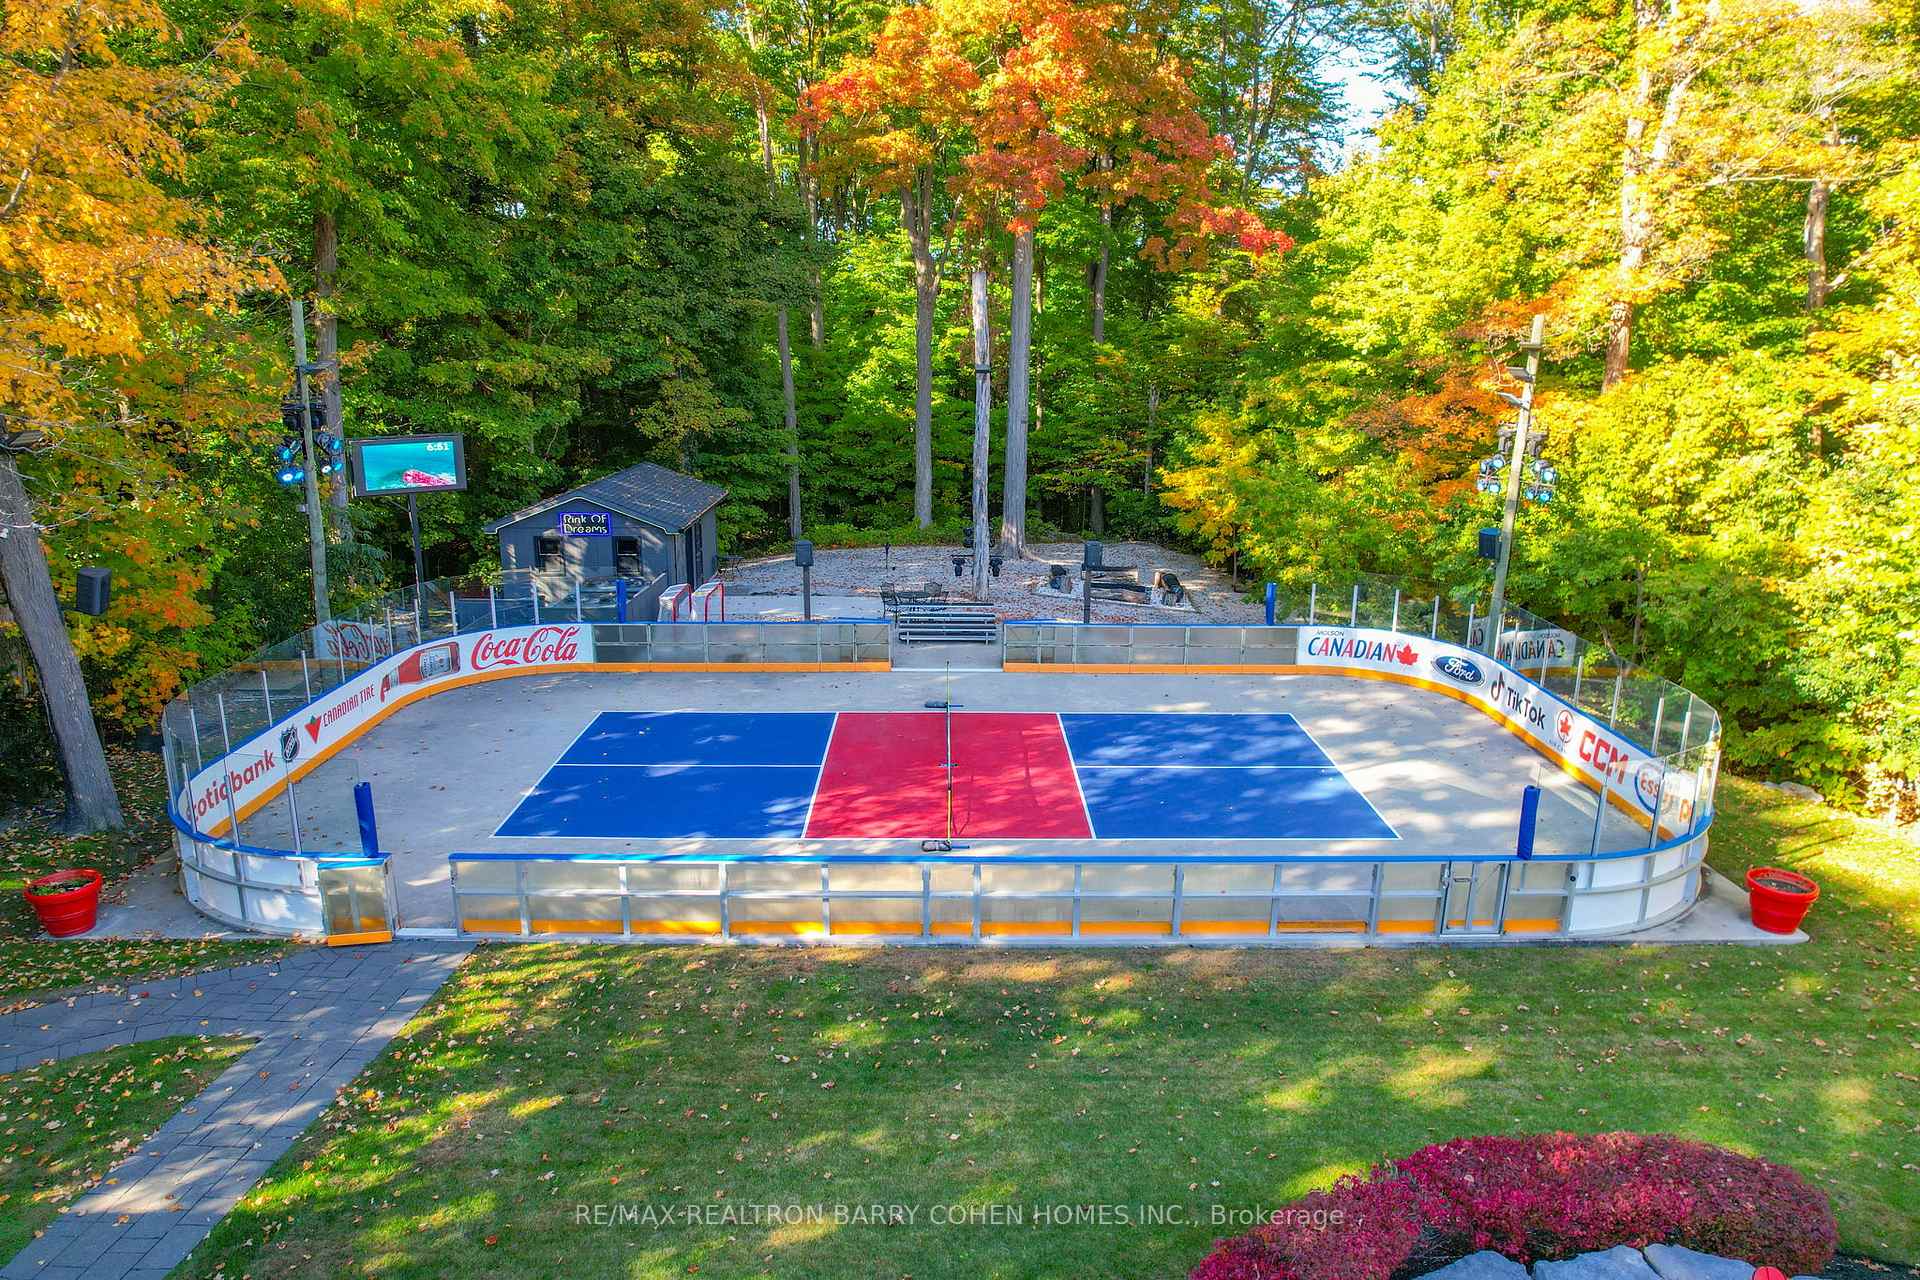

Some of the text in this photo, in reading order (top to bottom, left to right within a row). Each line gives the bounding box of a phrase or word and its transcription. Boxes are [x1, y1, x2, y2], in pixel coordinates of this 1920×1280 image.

[563, 514, 587, 524] Rink
[563, 523, 608, 534] Dreams
[470, 626, 581, 671] Coca-Cola
[1308, 636, 1397, 663] CANADIAN
[1443, 656, 1475, 682] Ford
[322, 684, 375, 727] CANADIAN TIRE
[1506, 687, 1546, 730] TikTok
[1579, 729, 1629, 785] CCM
